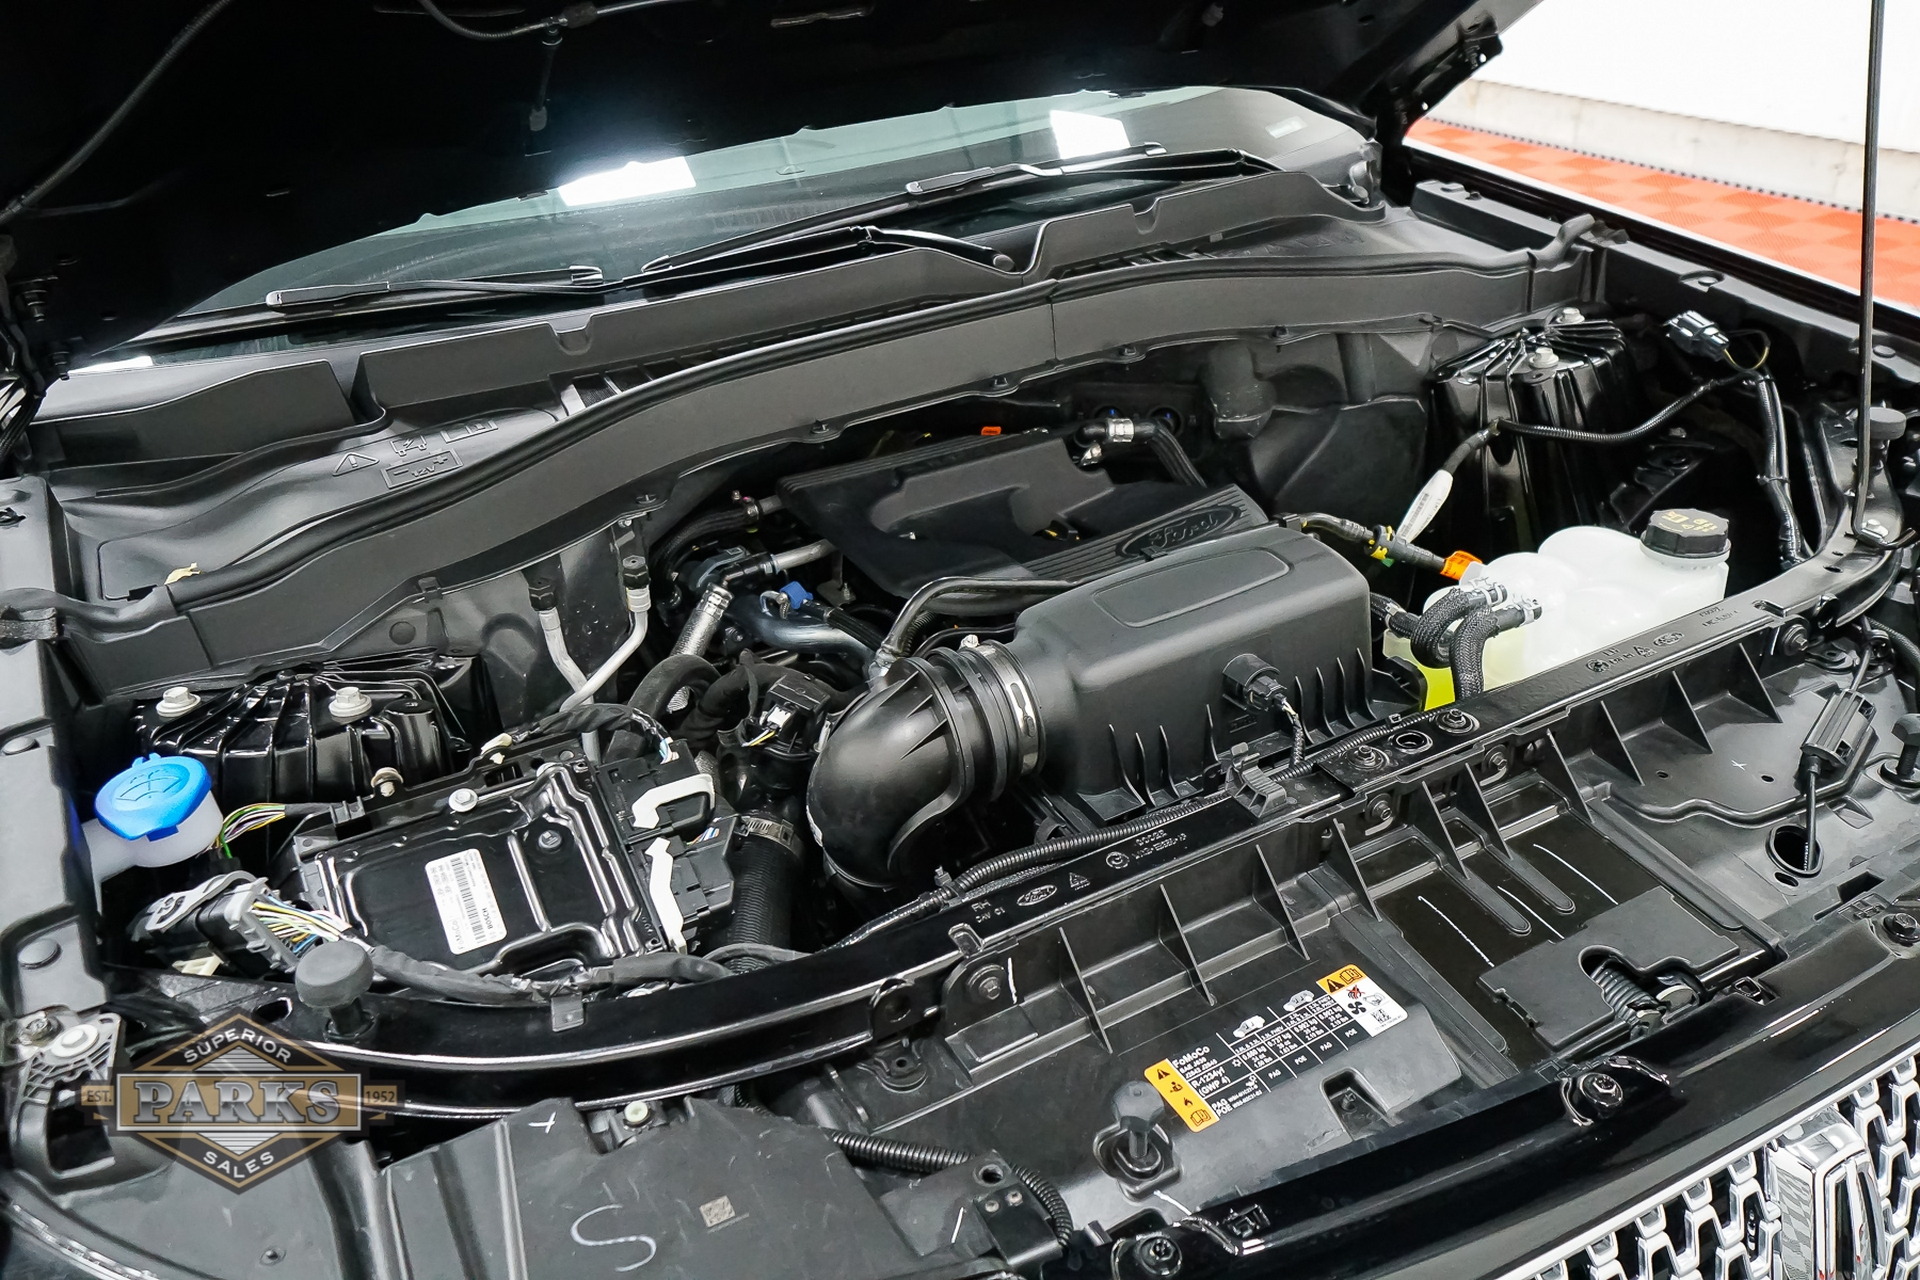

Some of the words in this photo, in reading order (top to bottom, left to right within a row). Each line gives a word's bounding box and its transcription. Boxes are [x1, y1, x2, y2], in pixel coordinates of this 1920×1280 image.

[411, 465, 436, 477] 12V
[1148, 514, 1218, 548] Ford
[482, 908, 493, 930] BOSCH
[1172, 1046, 1210, 1068] FoMoCo
[1268, 1069, 1281, 1079] PAG
[1295, 1055, 1307, 1065] POE
[1320, 1042, 1332, 1051] PAG
[1345, 1028, 1357, 1037] POE
[1190, 1066, 1225, 1088] R-1234yf
[1199, 1080, 1220, 1096] (GWP
[1211, 1098, 1228, 1110] PAG
[1215, 1103, 1233, 1116] POE
